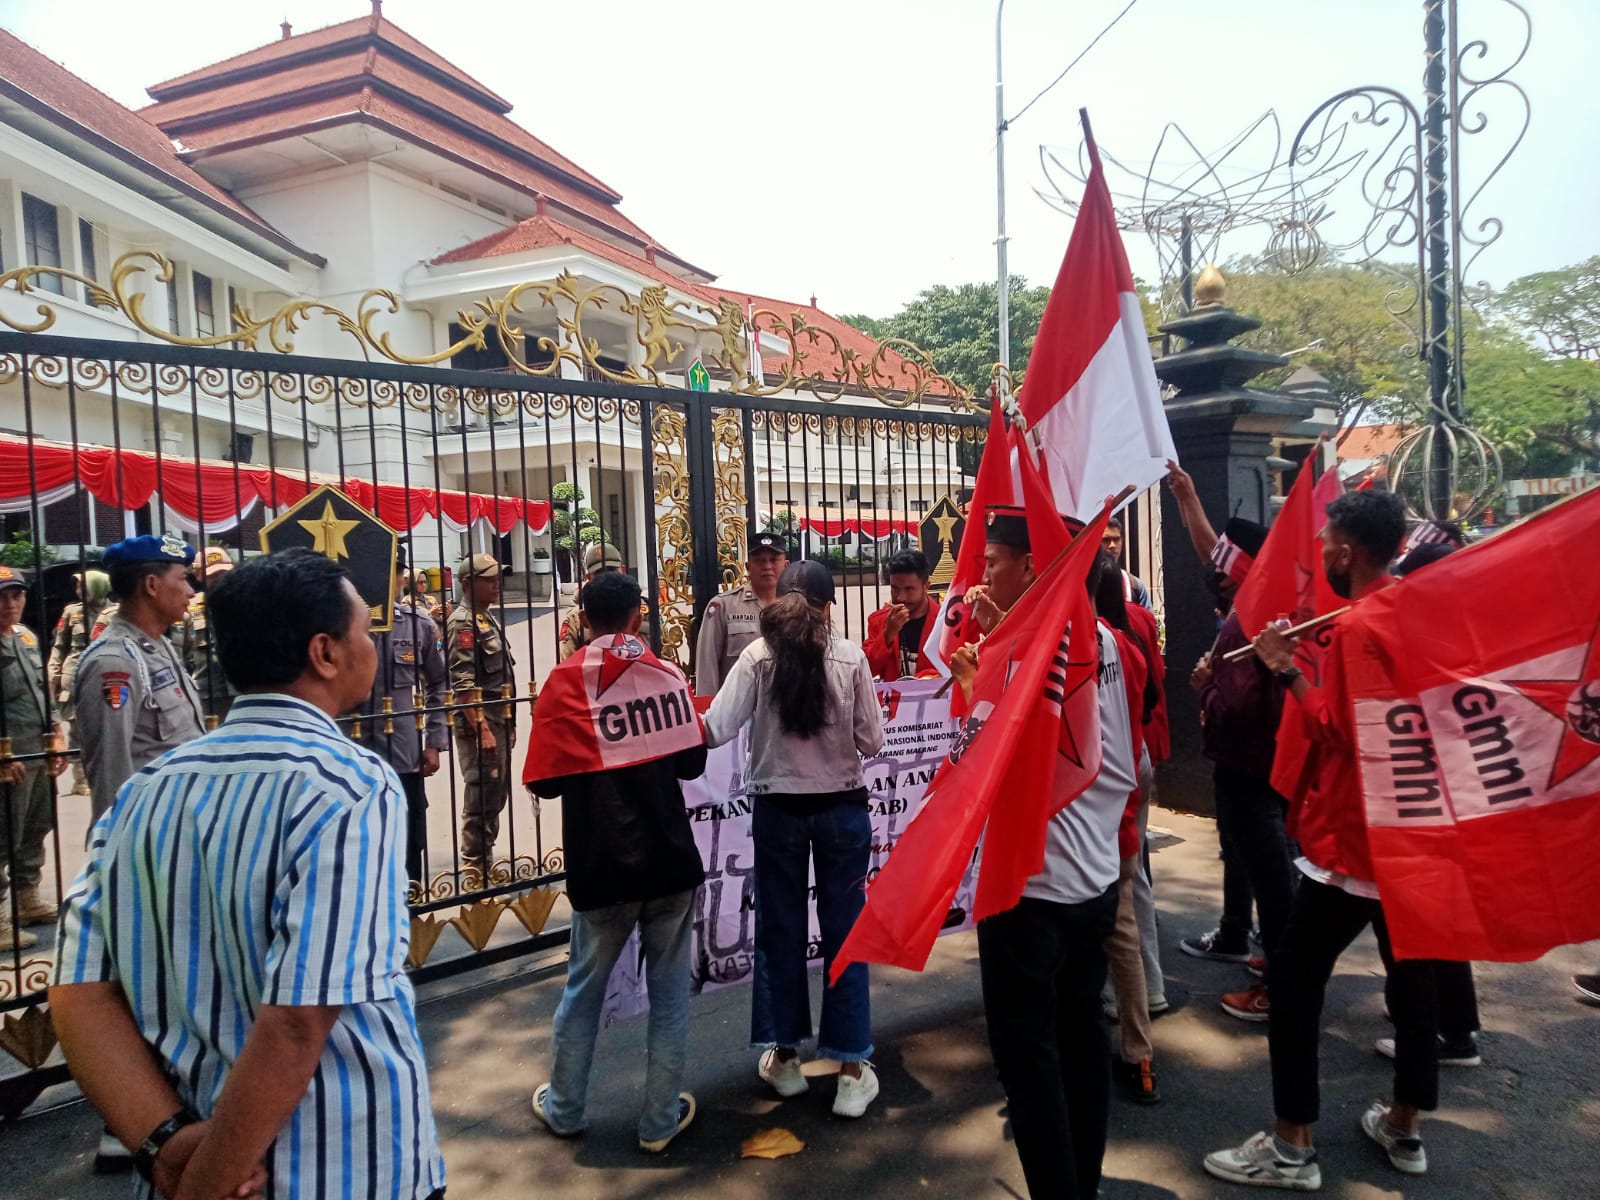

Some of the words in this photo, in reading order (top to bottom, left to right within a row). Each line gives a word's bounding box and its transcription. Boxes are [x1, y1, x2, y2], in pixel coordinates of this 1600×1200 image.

[393, 640, 422, 648] POLI
[897, 721, 944, 734] KOMISARIAT
[887, 734, 926, 746] NASIONAL
